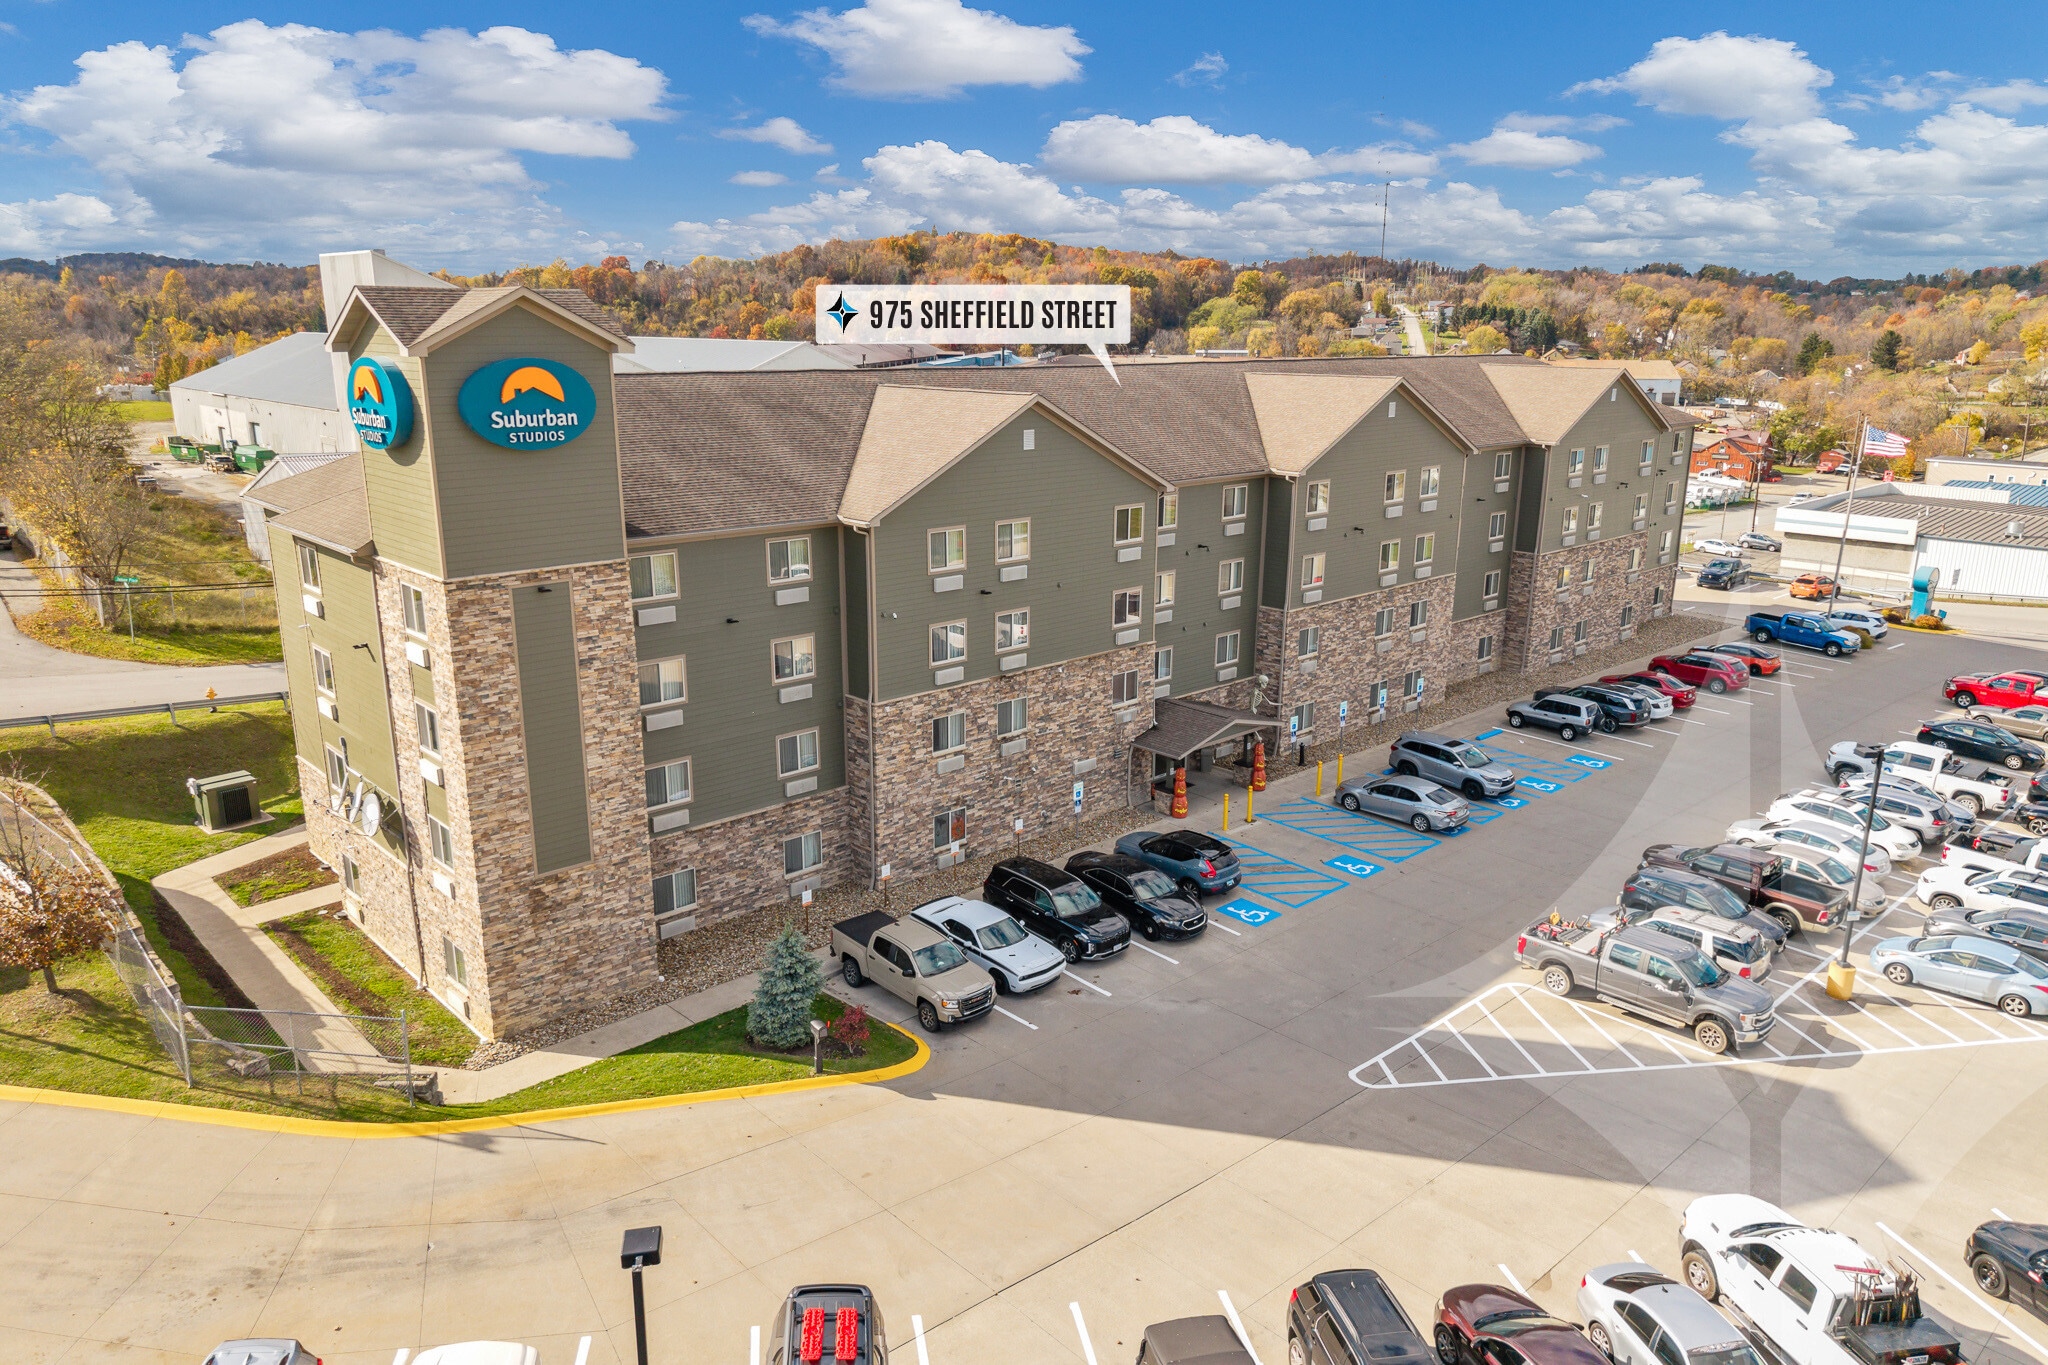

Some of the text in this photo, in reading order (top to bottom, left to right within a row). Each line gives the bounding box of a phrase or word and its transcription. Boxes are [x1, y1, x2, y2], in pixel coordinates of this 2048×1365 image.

[352, 407, 387, 428] Suburban
[491, 409, 578, 429] Suburban
[360, 430, 383, 443] STUDIOS
[509, 430, 565, 443] STUDIOS
